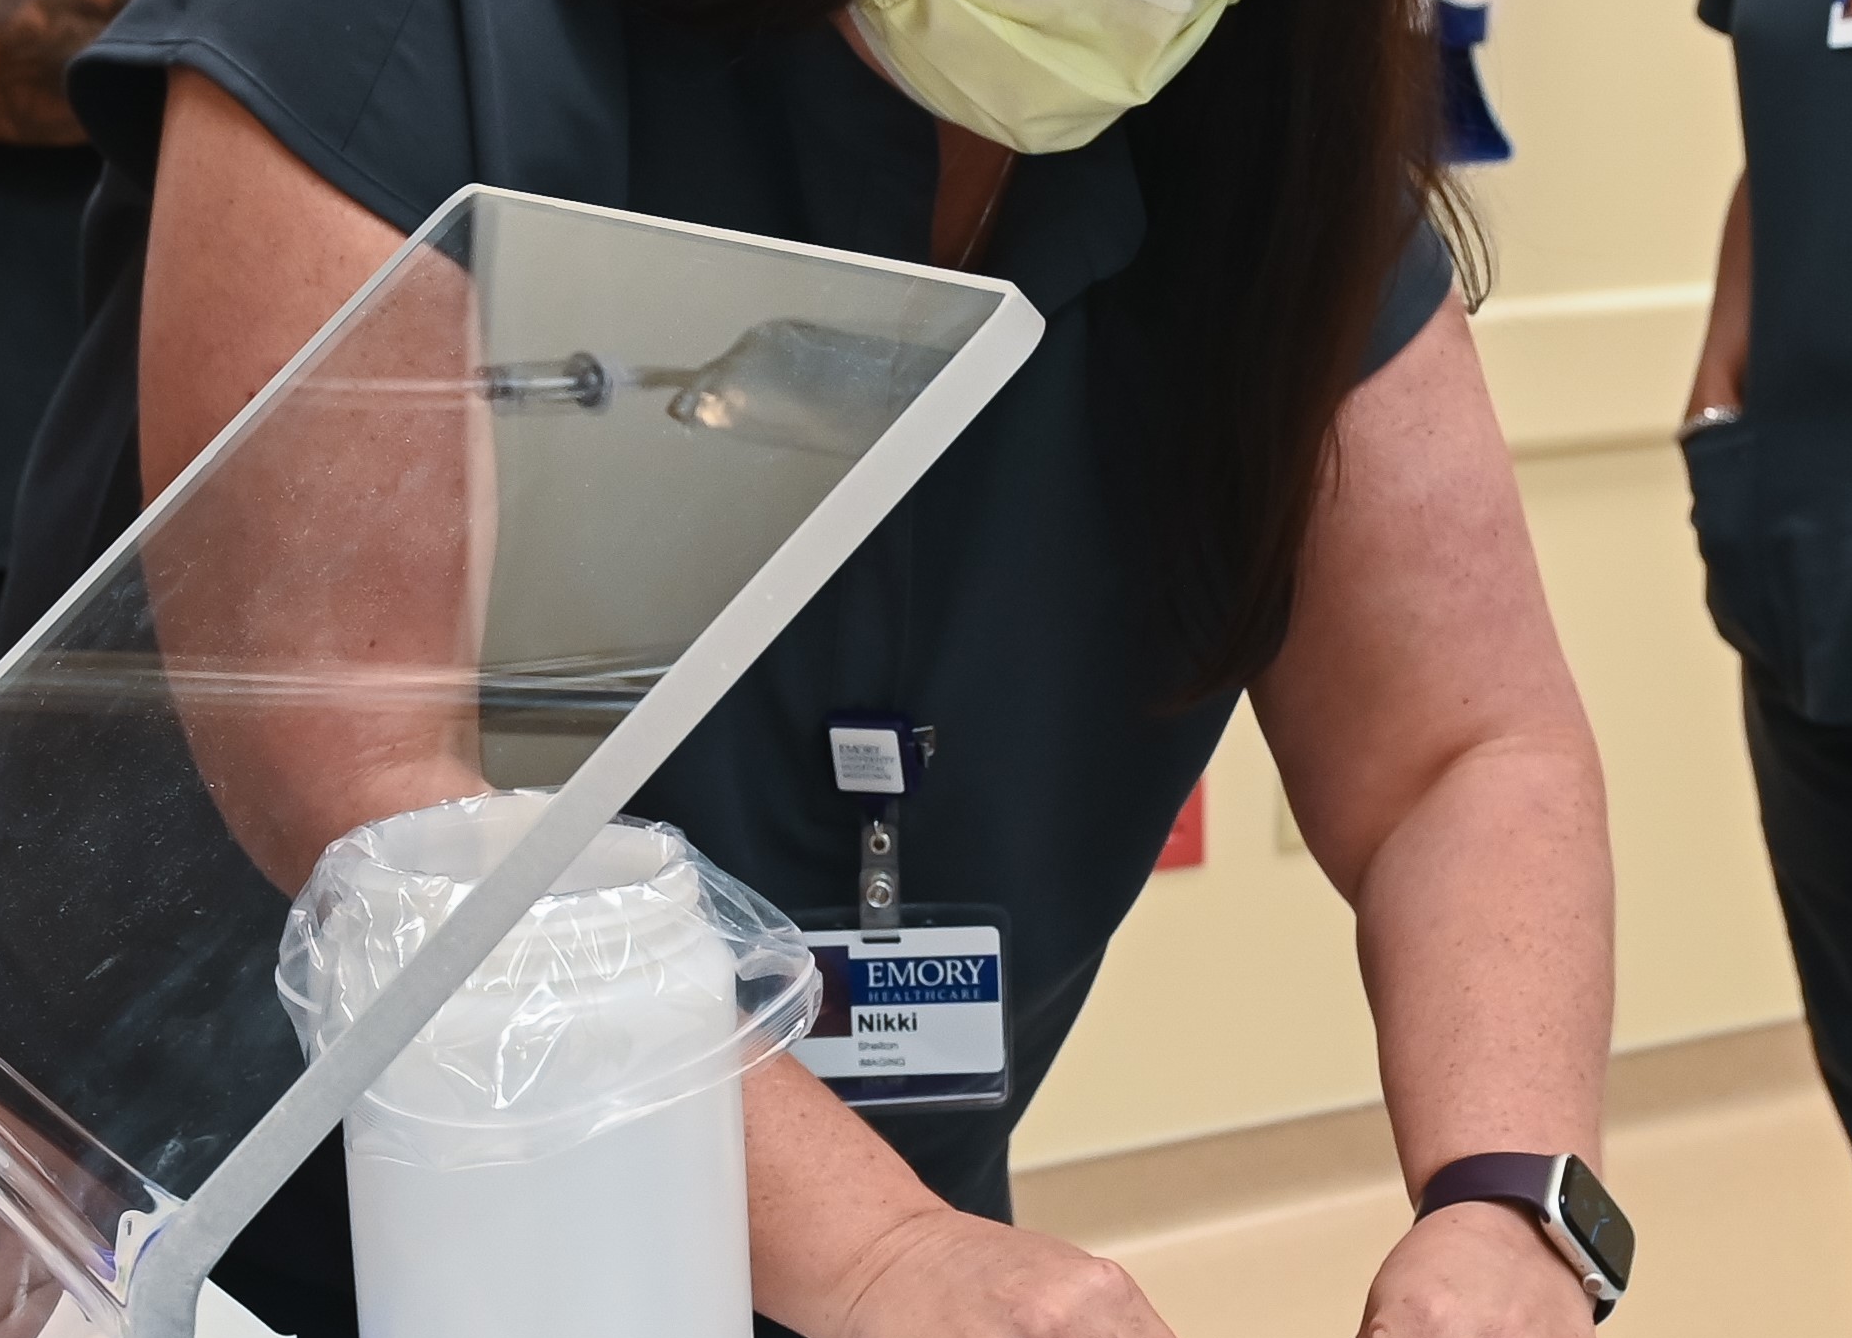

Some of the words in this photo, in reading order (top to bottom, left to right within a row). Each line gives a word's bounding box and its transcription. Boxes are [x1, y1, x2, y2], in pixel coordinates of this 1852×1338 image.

[867, 959, 985, 988] EMORY
[868, 988, 981, 1002] HEALTHCARE
[858, 1013, 918, 1032] Nikki
